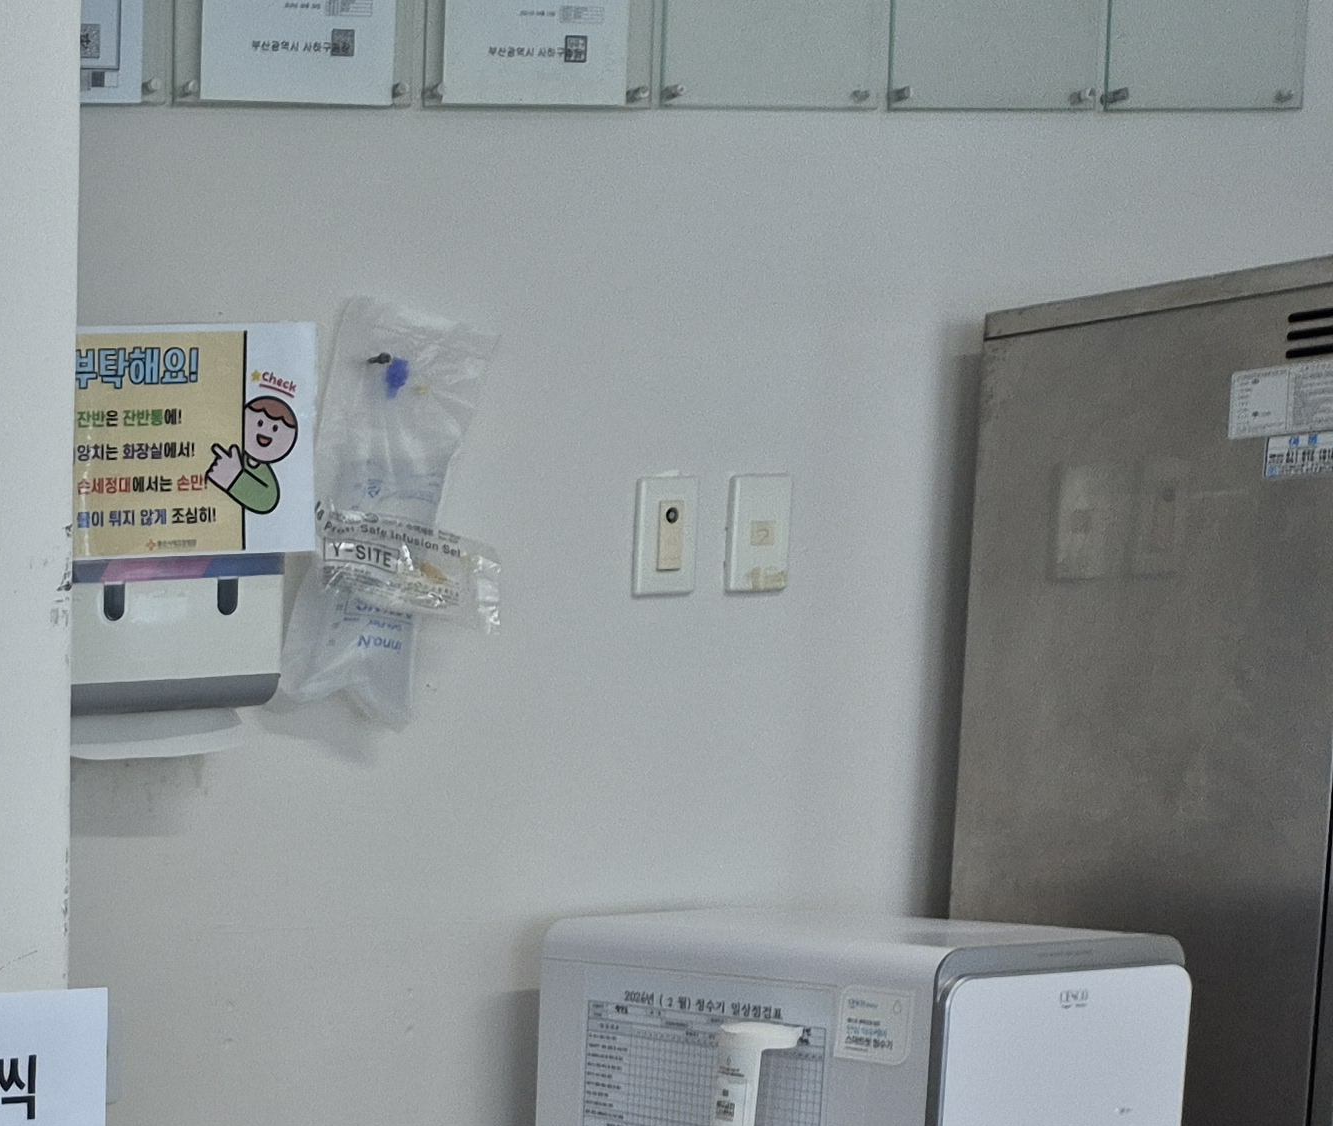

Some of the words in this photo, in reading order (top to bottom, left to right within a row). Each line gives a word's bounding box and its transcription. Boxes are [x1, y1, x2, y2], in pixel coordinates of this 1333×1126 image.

[75, 347, 198, 389] 부탁해요!
[262, 371, 297, 392] Check
[77, 410, 118, 428] 잔반은
[123, 408, 182, 426] 잔반통에!
[123, 442, 194, 459] 화장실에서!
[77, 476, 172, 495] 손세정대에서는
[177, 474, 208, 491] 손만!
[109, 510, 135, 526] 튀지
[140, 509, 166, 526] 않게
[172, 506, 216, 524] 조심히!
[360, 525, 387, 537] Safe
[391, 531, 438, 549] Infusion
[333, 542, 392, 567] Y-SITE
[696, 999, 725, 1014] 정수기
